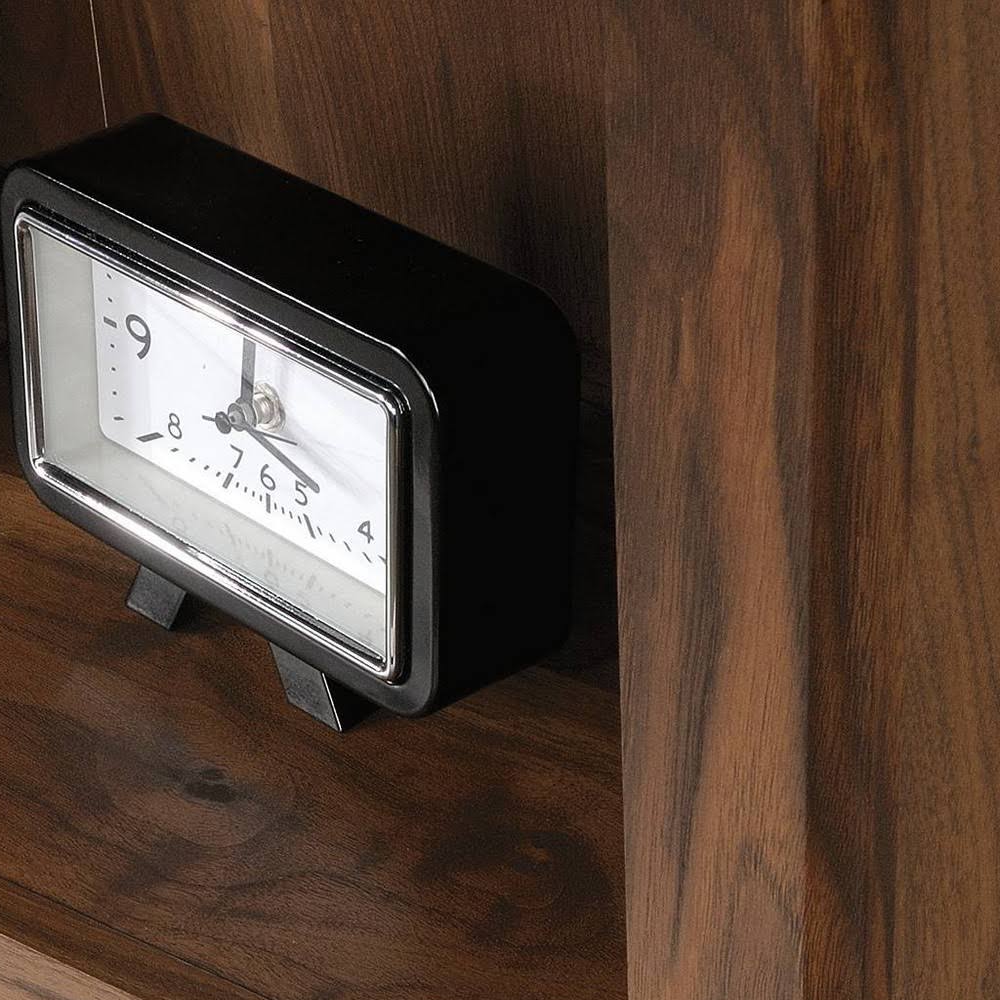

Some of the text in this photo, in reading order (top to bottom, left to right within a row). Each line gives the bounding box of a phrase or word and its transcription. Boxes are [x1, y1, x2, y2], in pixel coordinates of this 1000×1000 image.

[126, 314, 151, 359] 9
[168, 413, 182, 439] 8
[230, 444, 243, 468] 7
[260, 464, 275, 490] 6
[295, 480, 308, 506] 5
[358, 521, 374, 543] 4
